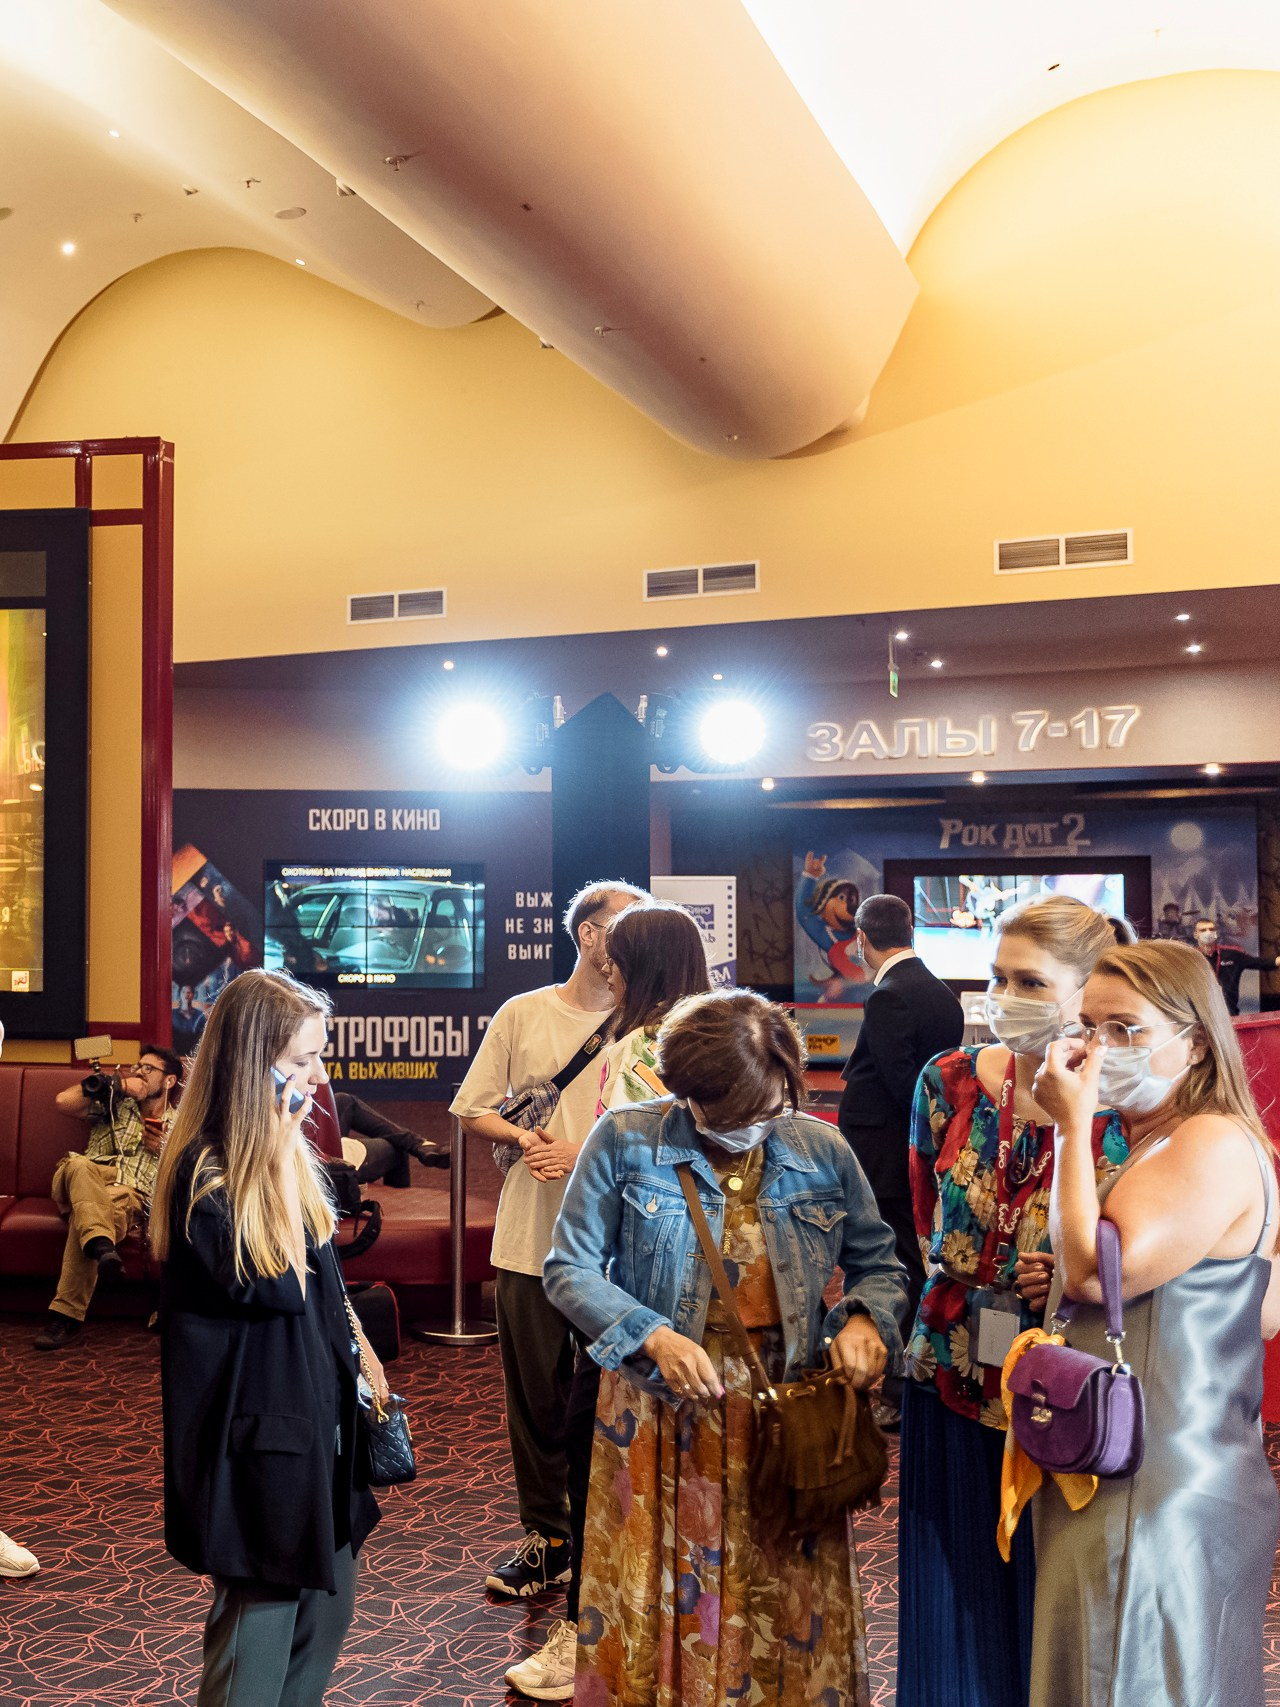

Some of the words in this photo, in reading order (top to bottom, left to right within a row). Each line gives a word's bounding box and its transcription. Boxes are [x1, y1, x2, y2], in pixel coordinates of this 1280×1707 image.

[806, 714, 998, 762] ЗАЛЫ
[1011, 703, 1141, 753] 7-17
[308, 808, 369, 831] СКОРО
[374, 808, 387, 831] В
[391, 808, 441, 831] КИНО
[505, 917, 525, 934] НЕ
[337, 974, 366, 984] СКОРО
[366, 974, 373, 984] В
[373, 974, 396, 984] КИНО
[348, 1061, 439, 1080] ВЫЖИВШИХ
